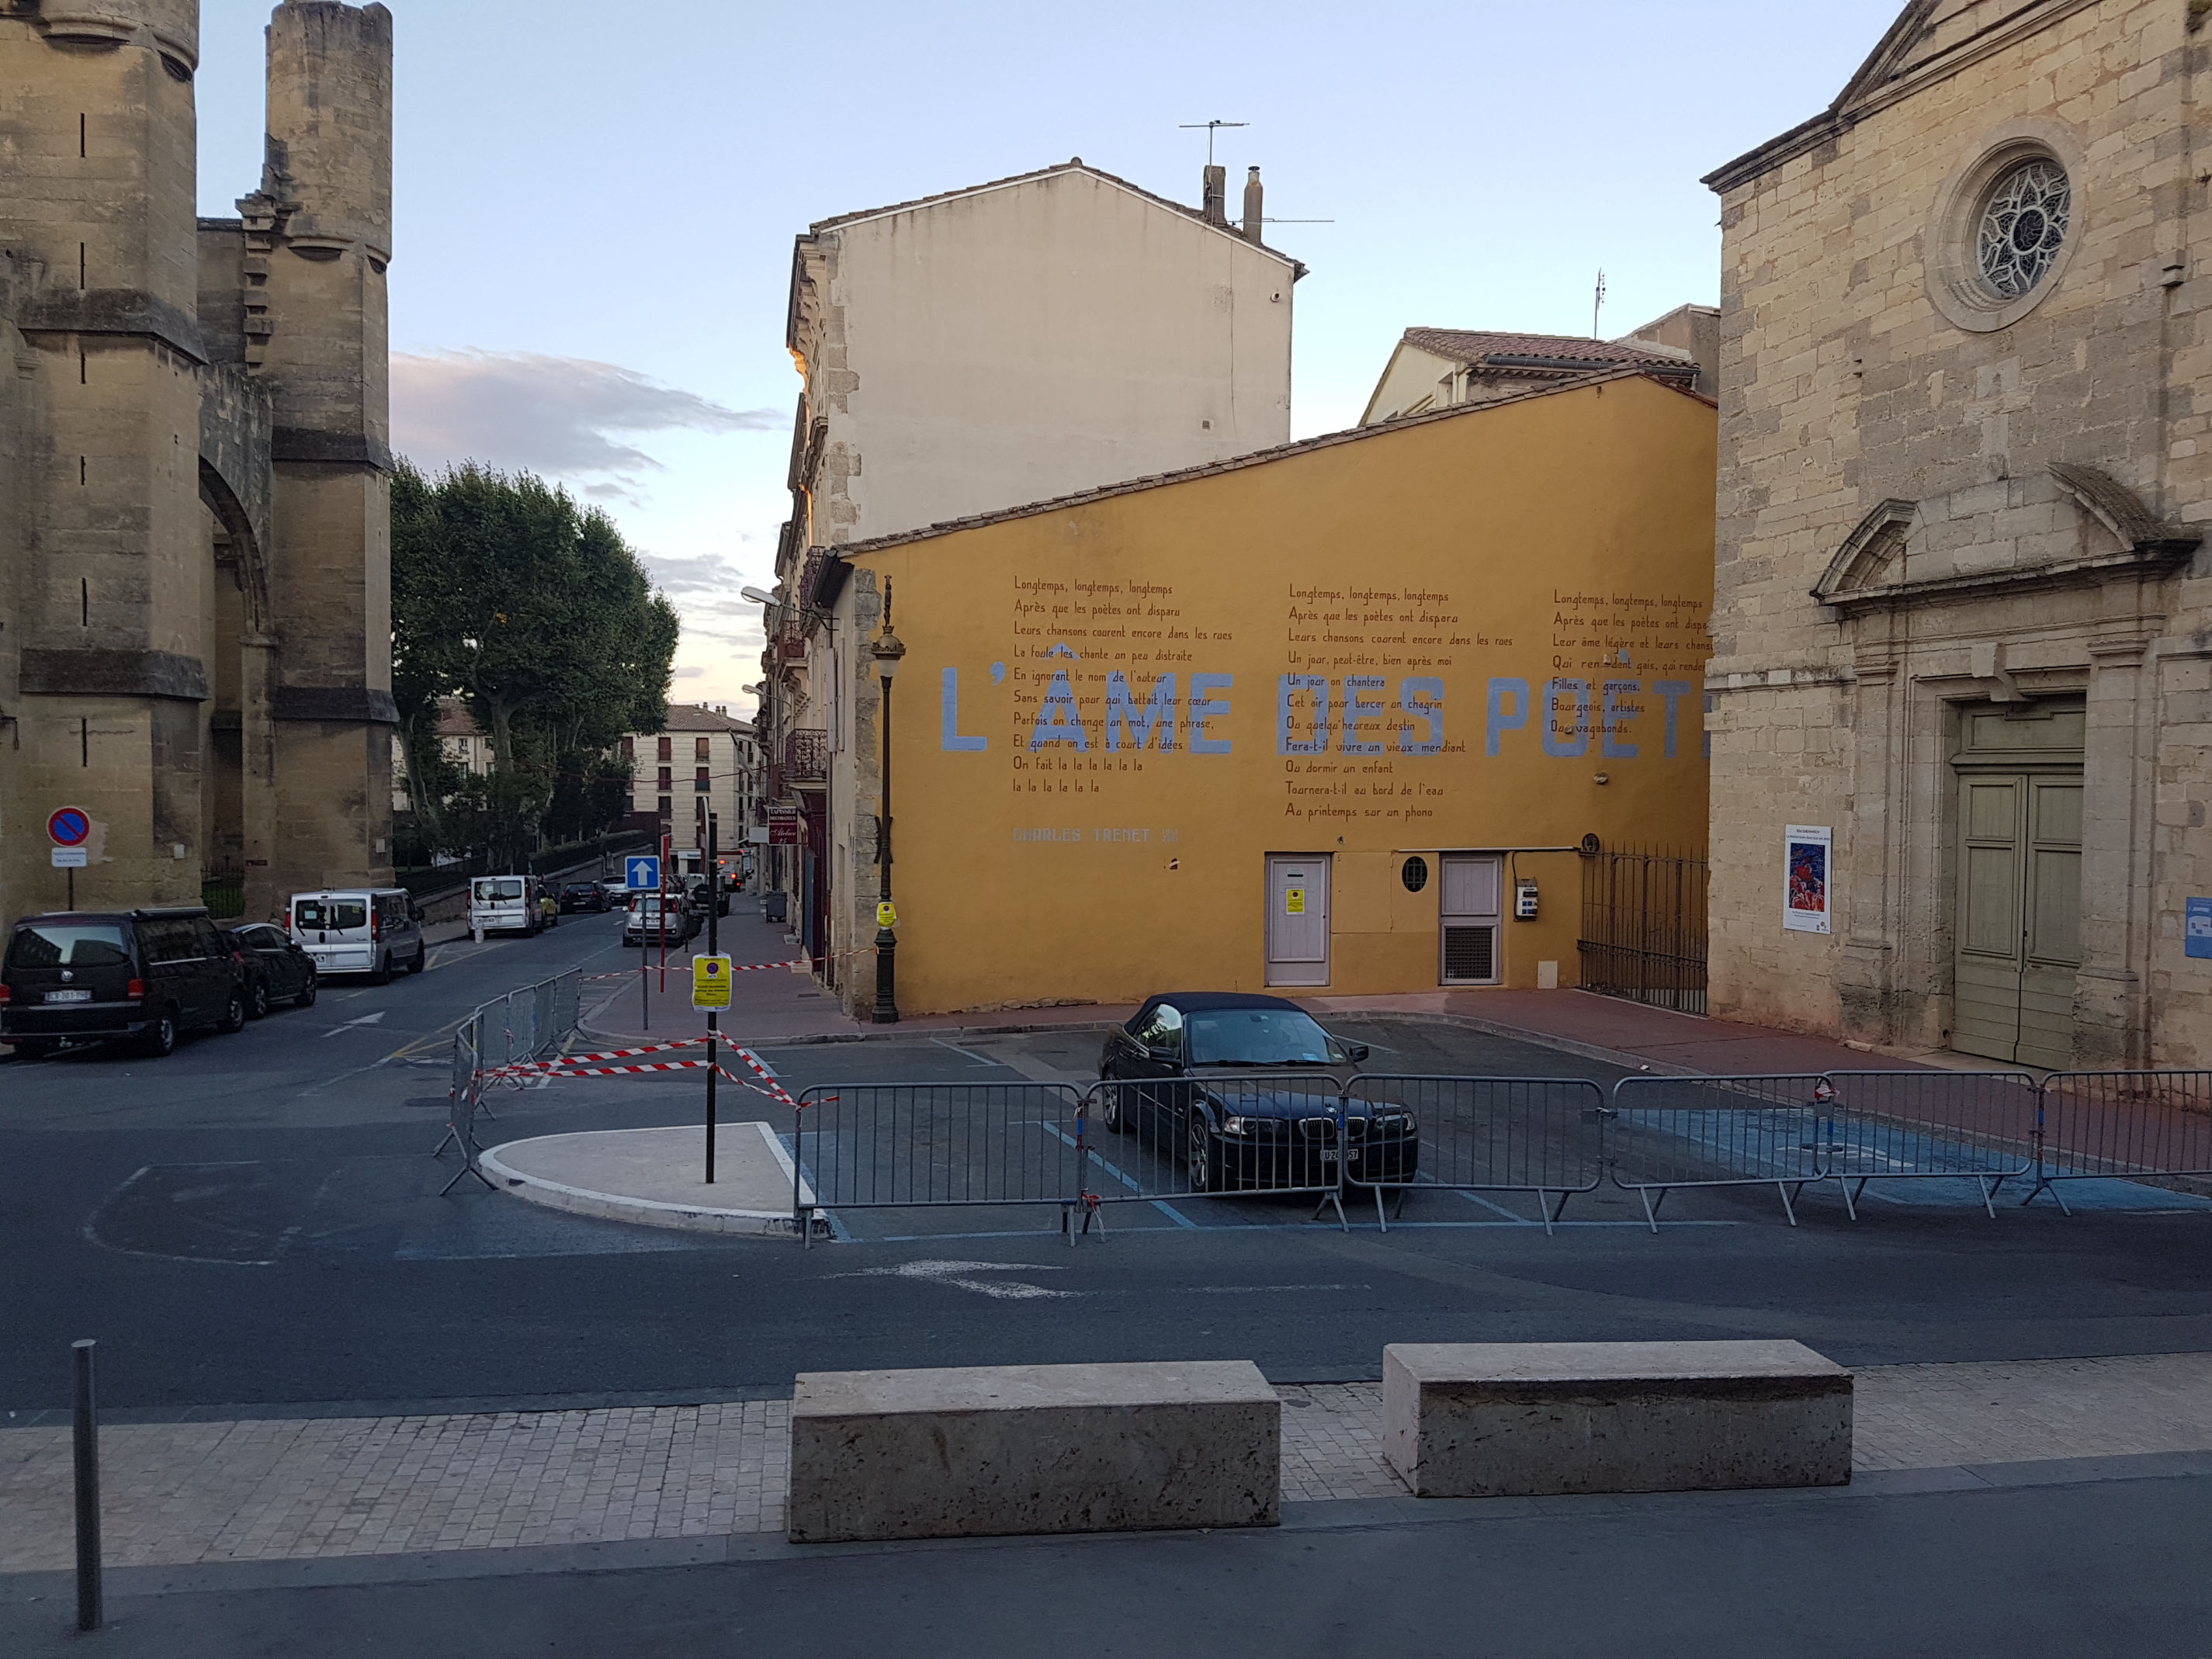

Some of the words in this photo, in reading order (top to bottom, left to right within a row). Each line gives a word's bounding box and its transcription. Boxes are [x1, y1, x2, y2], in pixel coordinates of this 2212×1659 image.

[1014, 575, 1068, 596] Longtemps,
[1074, 578, 1123, 597] longtemps,
[1129, 579, 1173, 599] longtemps
[1289, 583, 1345, 605] Longtemps,
[1349, 585, 1400, 606] longtemps,
[1404, 587, 1449, 607] longtemps
[1014, 598, 1045, 618] Après
[1052, 605, 1069, 619] que
[1074, 601, 1087, 614] les
[1092, 602, 1122, 620] poètes
[1126, 603, 1142, 615] ont
[1147, 602, 1181, 622] disparu
[1554, 589, 1608, 611] Longtemps,
[1612, 593, 1658, 611] longtemps,
[1661, 594, 1704, 614] longtemps
[1288, 605, 1318, 625] Après
[1323, 613, 1340, 626] que
[1345, 608, 1358, 621] les
[1363, 608, 1393, 627] poètes
[1399, 608, 1414, 622] ont
[1419, 609, 1458, 629] disparu
[1553, 611, 1585, 632] Après
[1590, 618, 1608, 632] que
[1613, 612, 1625, 627] les
[1631, 615, 1659, 633] poètes
[1665, 617, 1678, 629] ont
[1014, 620, 1041, 636] Leurs
[1046, 622, 1087, 637] chansons
[1092, 625, 1126, 638] courent
[1131, 630, 1162, 639] encore
[1167, 625, 1189, 639] dans
[1194, 626, 1208, 639] les
[1288, 627, 1316, 642] Leurs
[1323, 629, 1364, 643] chansons
[1371, 631, 1406, 644] courent
[1412, 636, 1442, 645] encore
[1448, 632, 1471, 645] dans
[1476, 632, 1489, 646] les
[1014, 643, 1025, 657] La
[1031, 644, 1054, 658] foule
[1060, 645, 1073, 659] les
[1079, 646, 1109, 660] chante
[1132, 653, 1149, 665] peu
[1155, 649, 1192, 661] distraite
[1553, 632, 1576, 647] Leur
[1581, 636, 1600, 647] âme
[1605, 635, 1635, 655] légère
[1640, 637, 1649, 649] et
[1655, 636, 1679, 649] leurs
[1288, 650, 1302, 663] Un
[1306, 656, 1330, 670] jour,
[1333, 653, 1378, 670] peut-être,
[1382, 653, 1401, 665] bien
[1407, 655, 1432, 671] après
[1437, 655, 1452, 666] moi
[1552, 654, 1572, 671] Qui
[1636, 663, 1658, 676] gais,
[1662, 660, 1676, 676] qui
[1014, 667, 1026, 681] En
[1031, 668, 1070, 687] ignorant
[1075, 668, 1083, 681] le
[1112, 669, 1125, 683] de
[1130, 670, 1167, 684] l'auteur
[1287, 671, 1301, 686] Un
[1305, 674, 1326, 692] jour
[1347, 674, 1385, 687] chantera
[1552, 676, 1578, 690] Filles
[1586, 677, 1597, 690] et
[1603, 683, 1640, 696] garçons,
[1014, 689, 1038, 703] Sans
[1043, 692, 1073, 705] savoir
[1079, 696, 1101, 711] pour
[1104, 693, 1121, 711] qui
[1128, 691, 1158, 705] battait
[1164, 692, 1182, 705] leur
[1187, 698, 1212, 706] cœur
[1277, 674, 1446, 757] DES
[1486, 647, 1712, 759] POÈT
[1287, 693, 1305, 708] Cet
[1310, 697, 1323, 708] air
[1328, 701, 1350, 714] pour
[1355, 694, 1385, 708] bercer
[1408, 695, 1442, 715] chagrin
[1552, 697, 1606, 718] Bourgeois,
[1610, 699, 1645, 712] artistes
[1014, 711, 1048, 726] Parfois
[1070, 713, 1104, 733] change
[1128, 715, 1149, 729] mot,
[1180, 715, 1214, 733] phrase,
[1286, 715, 1301, 729] Ou
[1386, 717, 1415, 731] destin
[1575, 719, 1633, 739] vagabonds.
[1013, 733, 1025, 747] Et
[1030, 734, 1061, 754] quand
[1067, 740, 1078, 749] on
[1083, 736, 1099, 749] est
[1105, 738, 1111, 749] à
[1115, 737, 1142, 750] court
[1147, 736, 1183, 750] d'idées
[1285, 736, 1328, 752] Fera-t-il
[1386, 741, 1413, 752] vieux
[1421, 739, 1466, 753] mendiant
[1013, 755, 1028, 770] On
[1035, 757, 1053, 771] fait
[1058, 757, 1067, 771] la
[1073, 757, 1082, 771] la
[1089, 757, 1097, 771] la
[1104, 757, 1112, 771] la
[1118, 758, 1128, 771] la
[1133, 758, 1142, 771] la
[1285, 759, 1301, 773] Ou
[1305, 760, 1338, 773] dormir
[1362, 760, 1393, 774] enfant
[1013, 778, 1021, 792] la
[1028, 778, 1037, 792] la
[1043, 778, 1052, 792] la
[1059, 778, 1068, 792] la
[1074, 778, 1083, 792] la
[1090, 778, 1099, 793] la
[1285, 781, 1347, 795] Tournera-t-il
[1372, 781, 1394, 795] bord
[1400, 781, 1413, 795] de
[1419, 782, 1444, 795] l'eau
[1285, 802, 1302, 816] Au
[1308, 803, 1357, 823] printemps
[1405, 804, 1433, 823] phono
[1012, 827, 1081, 842] CHARLES
[1094, 828, 1150, 842] TRENET
